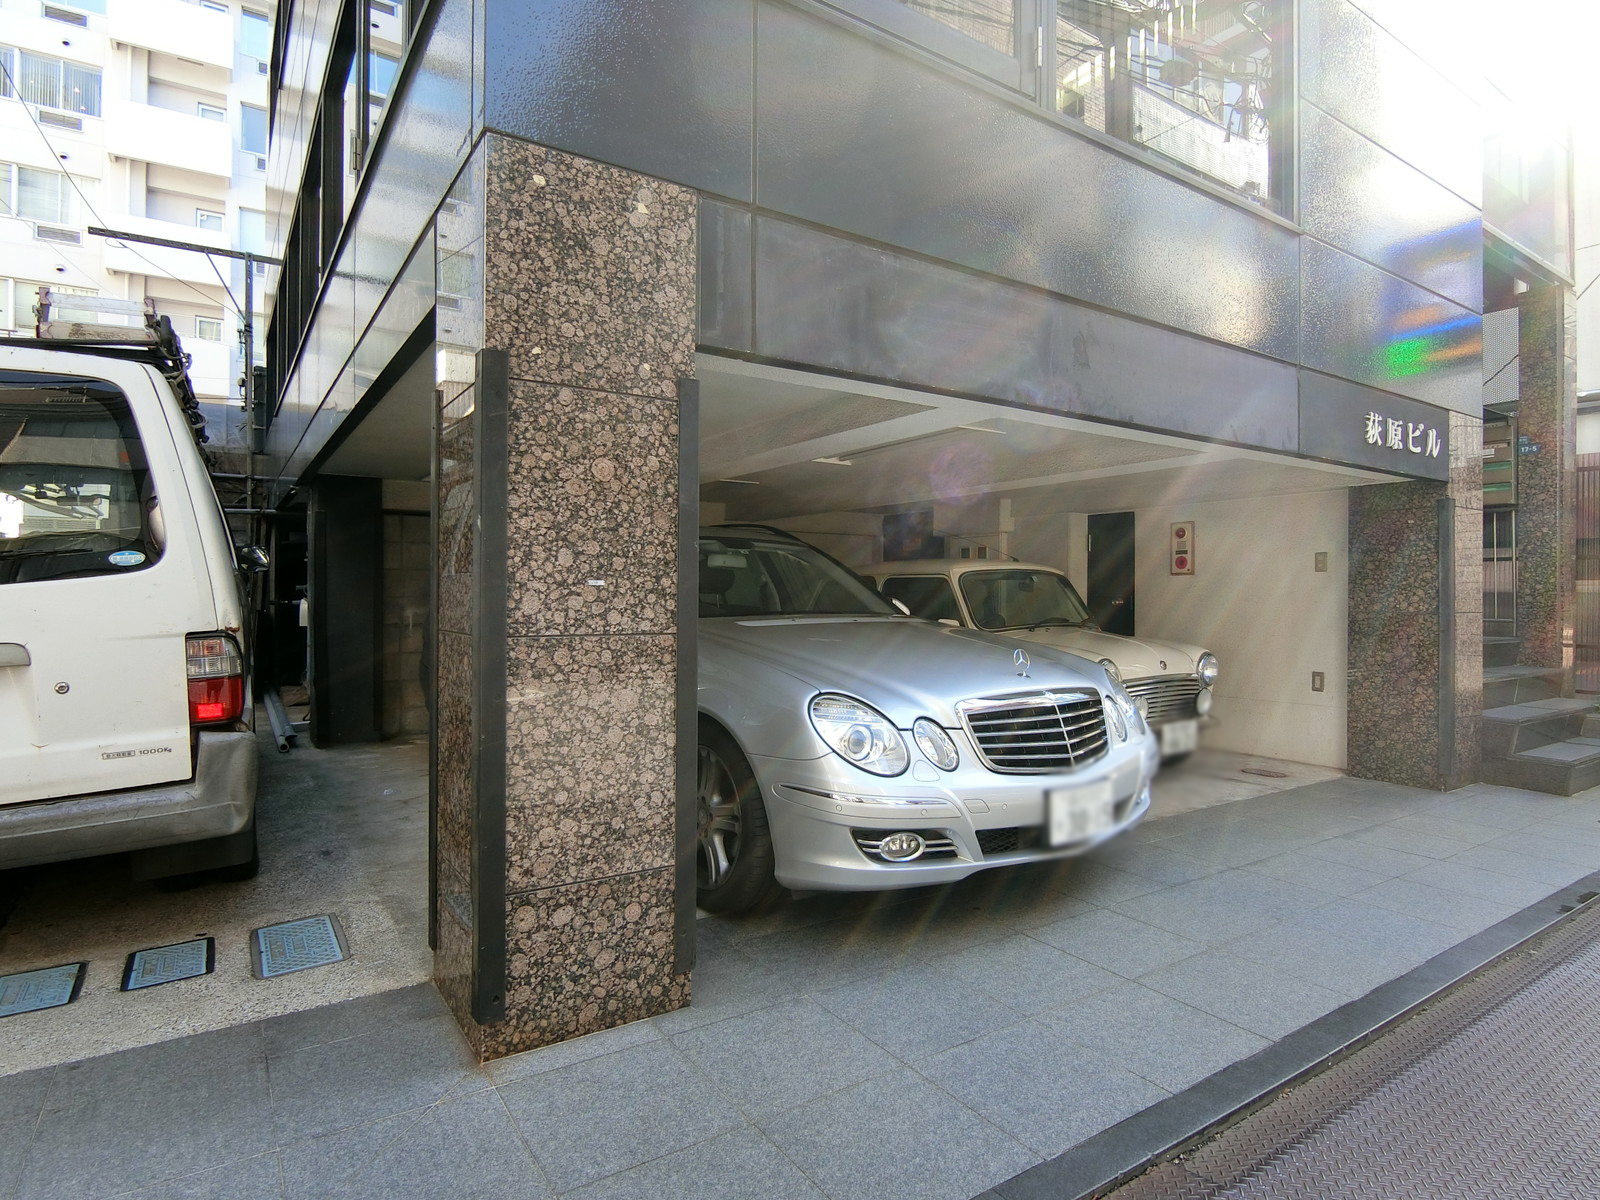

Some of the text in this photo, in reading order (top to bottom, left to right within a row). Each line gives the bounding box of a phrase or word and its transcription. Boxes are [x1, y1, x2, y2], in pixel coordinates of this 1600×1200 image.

[1364, 412, 1441, 458] 荻原ビル
[1521, 445, 1537, 453] 17-5
